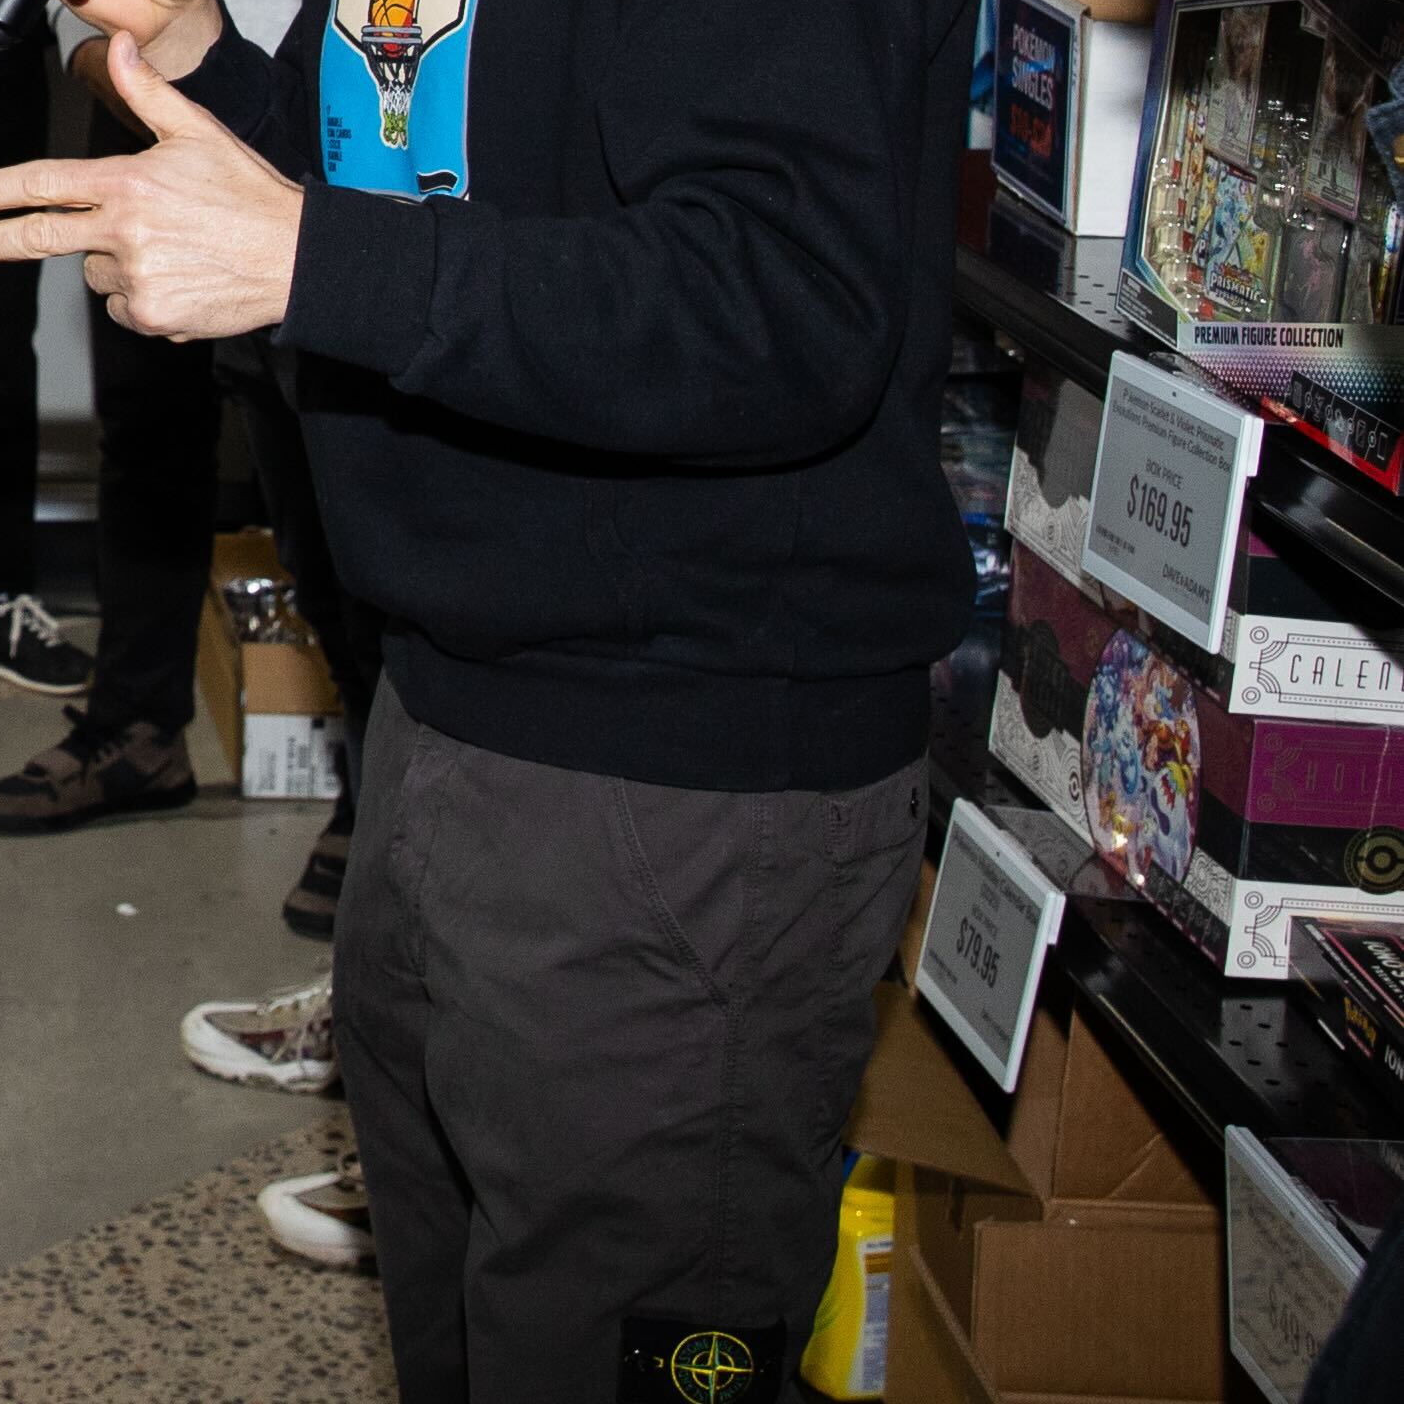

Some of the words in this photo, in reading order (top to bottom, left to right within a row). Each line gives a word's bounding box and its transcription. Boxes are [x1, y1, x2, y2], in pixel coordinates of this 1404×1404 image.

[1011, 55, 1054, 112] SINGLES
[1210, 272, 1260, 302] PRISMATIC
[1194, 326, 1239, 346] PREMIUM
[1242, 327, 1277, 346] FIGURE
[1280, 328, 1344, 348] COLLECTION
[1167, 430, 1186, 452] Figure
[1186, 438, 1217, 463] Collection
[1146, 458, 1162, 477] BOX
[1162, 466, 1184, 491] PRICE
[1126, 473, 1193, 548] $169.95
[956, 917, 999, 988] $79.95
